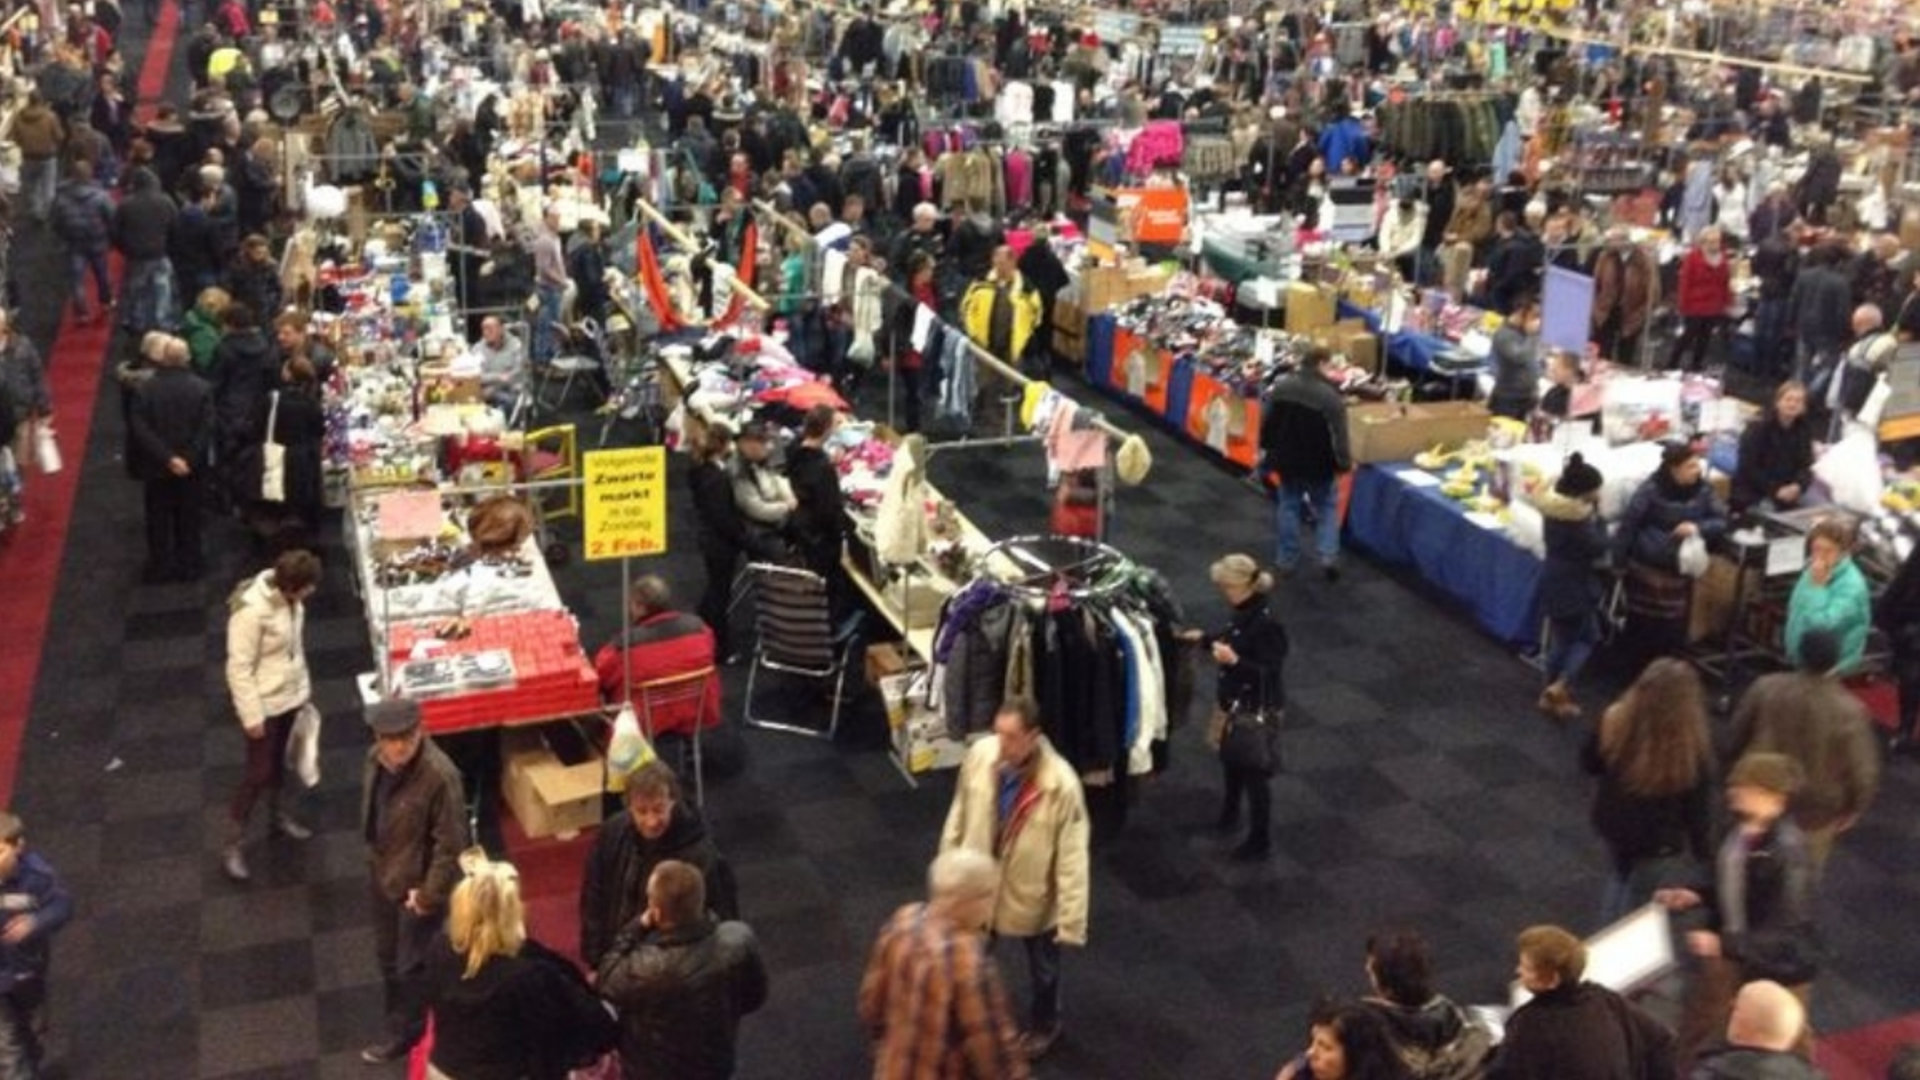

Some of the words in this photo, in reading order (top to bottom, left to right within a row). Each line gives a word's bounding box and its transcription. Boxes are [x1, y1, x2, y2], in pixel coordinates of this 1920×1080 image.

[593, 471, 656, 485] Zwarte
[599, 488, 650, 502] markt
[598, 520, 652, 534] Zondag
[591, 540, 604, 554] 2
[612, 537, 660, 553] Feb.
